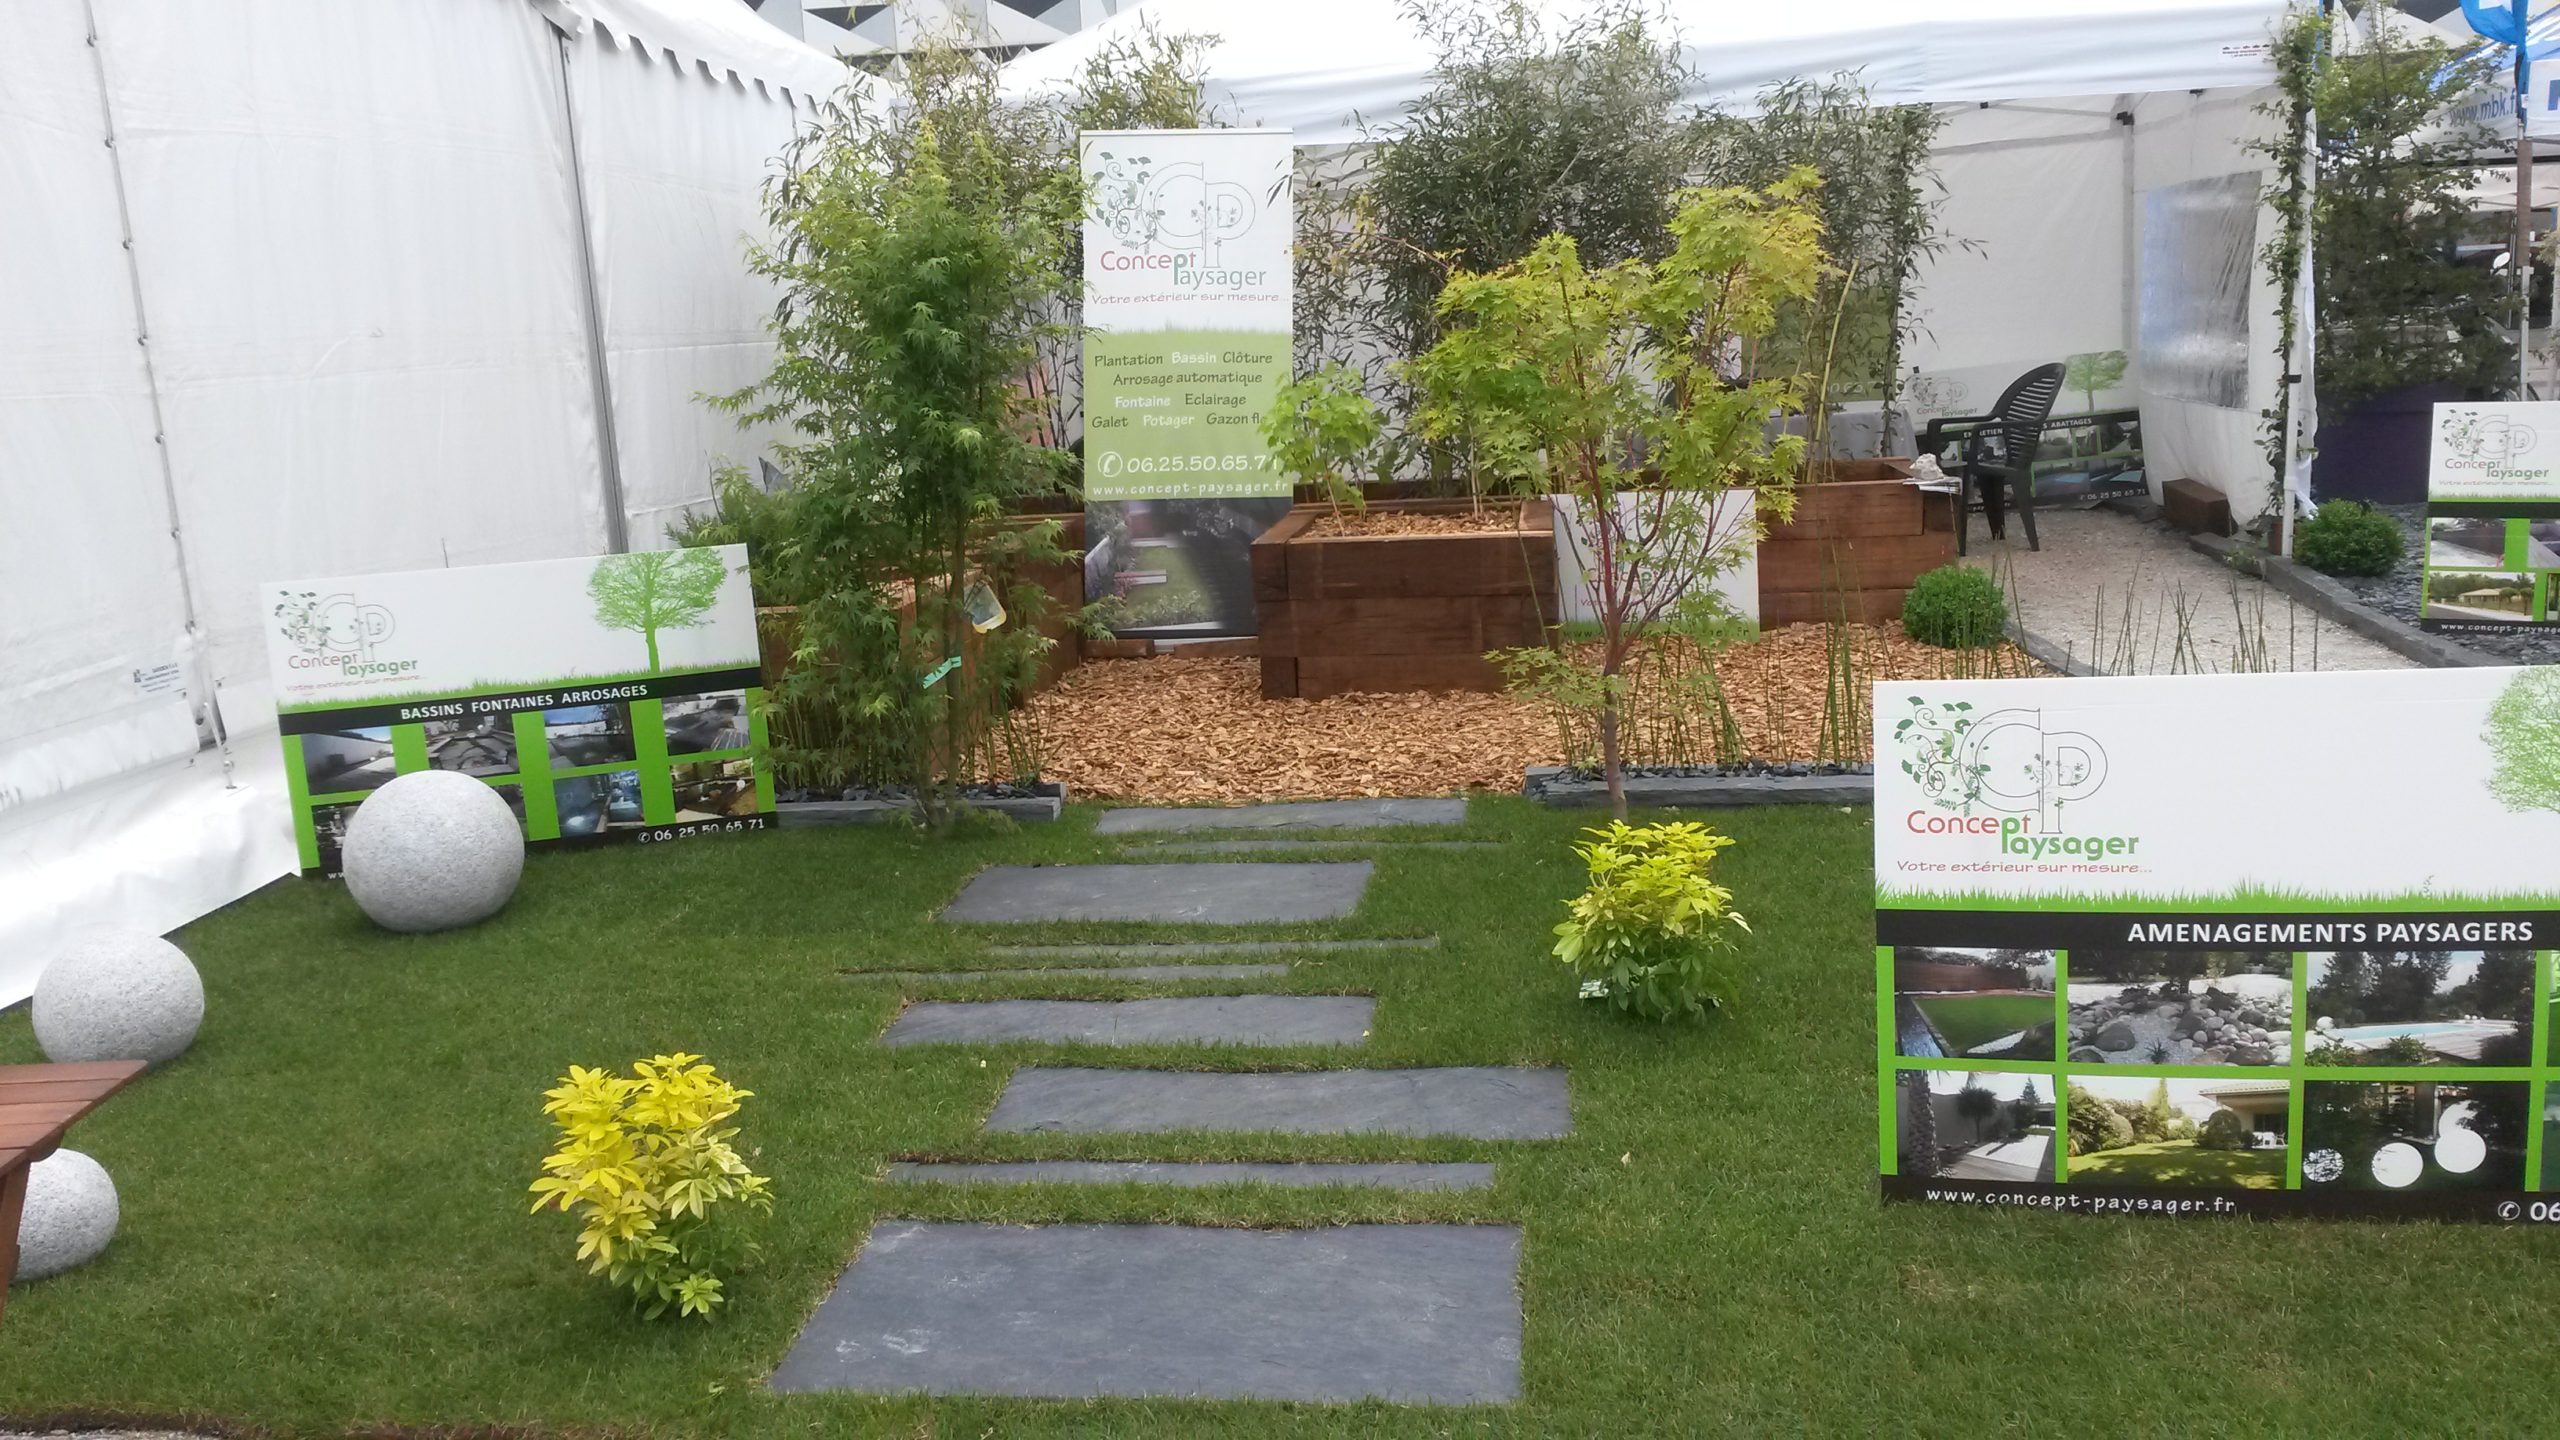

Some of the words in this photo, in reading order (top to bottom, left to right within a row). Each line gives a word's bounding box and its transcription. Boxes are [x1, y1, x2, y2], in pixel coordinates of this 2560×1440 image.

[1100, 250, 1197, 276] Concept
[1092, 294, 1130, 305] Votre
[1133, 291, 1196, 303] extérieur
[1200, 292, 1224, 301] sur
[1094, 353, 1164, 368] Plantation
[1171, 351, 1217, 365] Bassin
[1222, 351, 1273, 365] Clôture
[1113, 373, 1173, 387] Arrosage
[1176, 371, 1263, 387] automatique
[1114, 395, 1171, 409] Fontaine
[1185, 392, 1247, 409] Eclairage
[1091, 415, 1129, 429] Galet
[1143, 414, 1196, 430] Potager
[1206, 412, 1249, 426] Gazon
[2051, 417, 2092, 429] ABATTAGES
[2444, 458, 2501, 473] Concept
[1092, 480, 1288, 497] www.concept-paysager.fr
[288, 654, 358, 673] Concept
[400, 702, 464, 721] BASSINS
[471, 693, 555, 714] FONTAINES
[561, 683, 648, 705] ARROSAGES
[654, 829, 673, 842] 06
[678, 825, 696, 838] 25
[725, 820, 743, 833] 65
[748, 818, 765, 830] 71
[1906, 809, 2031, 840] Concept
[1897, 860, 1946, 873] Votre
[1950, 859, 2034, 874] extérieur
[2037, 862, 2068, 874] sur
[2127, 922, 2367, 944] AMENAGEMENTS
[2376, 920, 2534, 943] PAYSAGERS
[1926, 1187, 2236, 1214] www.concept-paysager.fr
